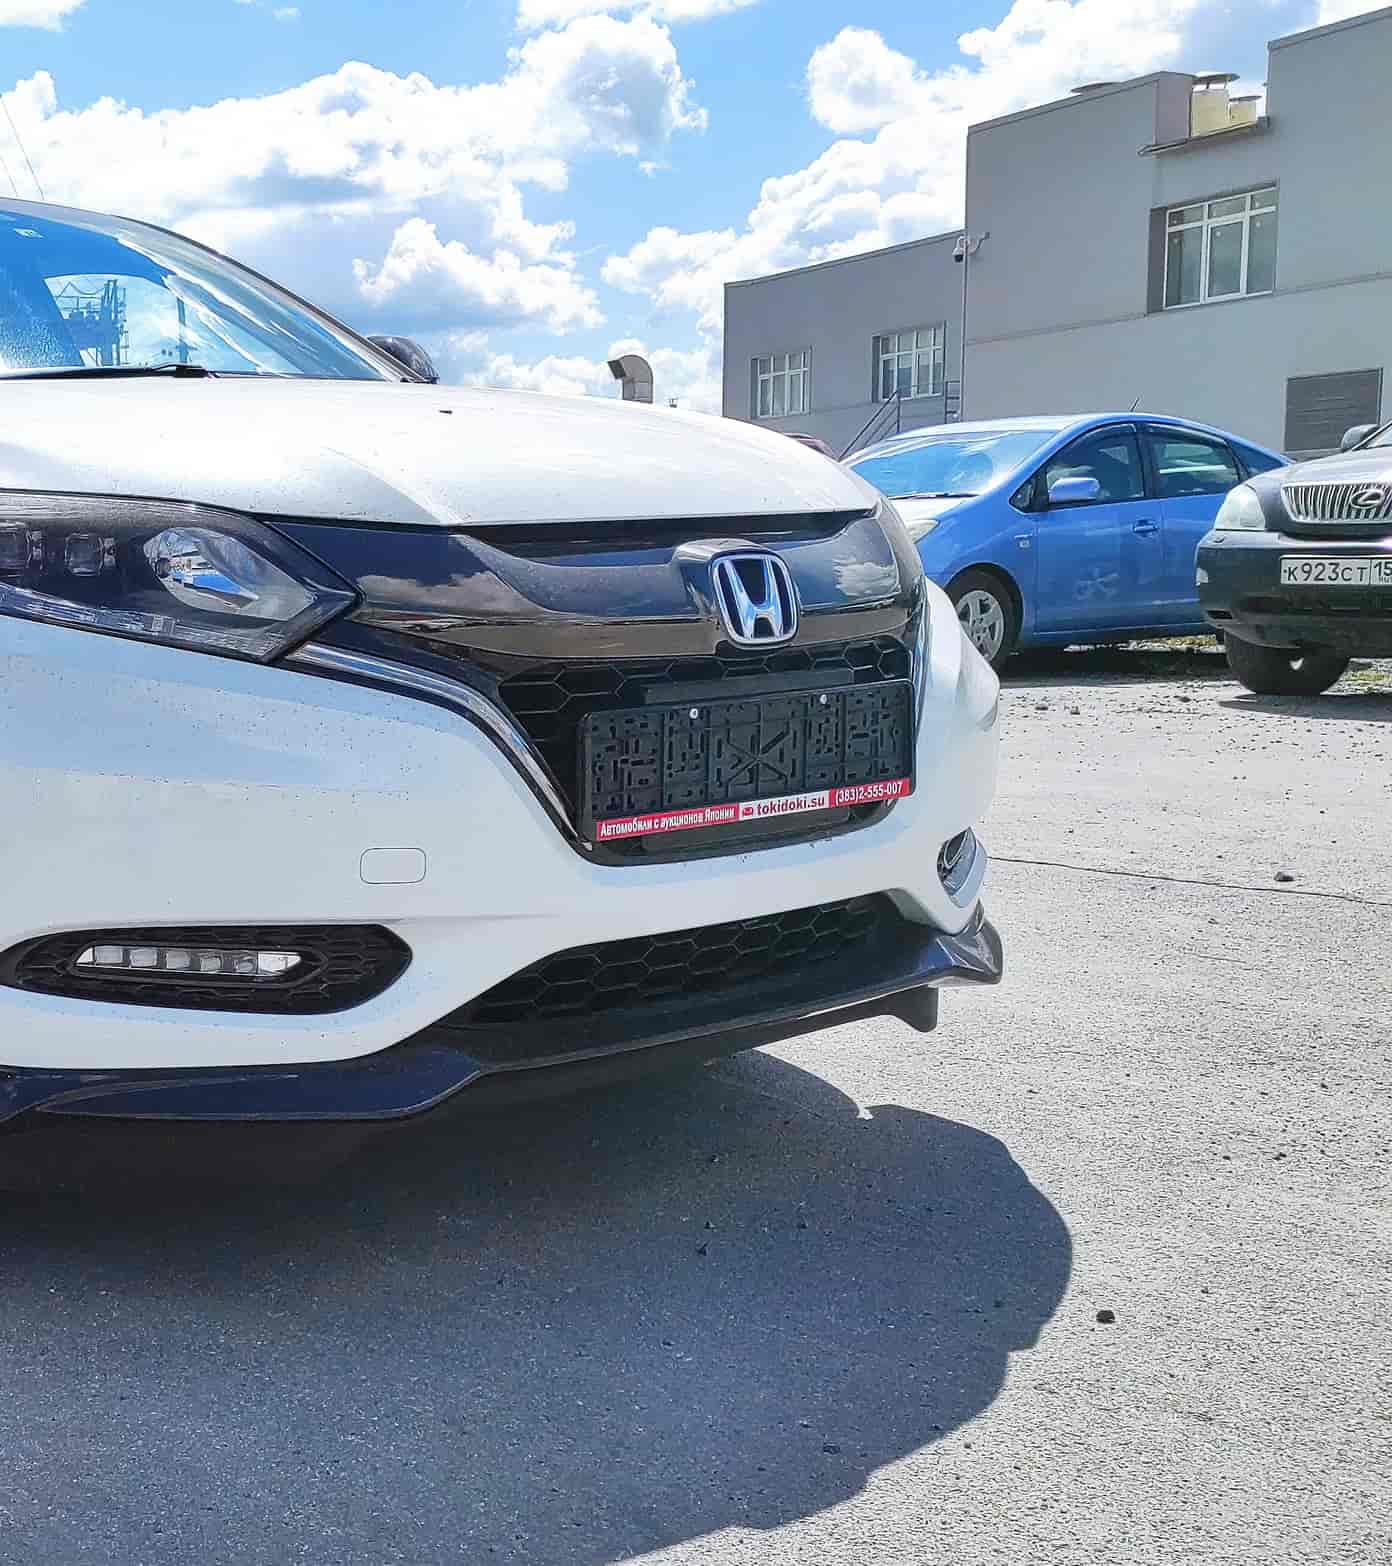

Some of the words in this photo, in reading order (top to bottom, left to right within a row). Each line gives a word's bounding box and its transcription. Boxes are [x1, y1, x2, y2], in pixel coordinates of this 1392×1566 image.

[835, 782, 903, 805] (383)2-555-007
[757, 796, 825, 815] tokidoki.su
[601, 819, 652, 837] Автомобили
[660, 813, 703, 830] аукционов
[704, 808, 735, 822] Японии
